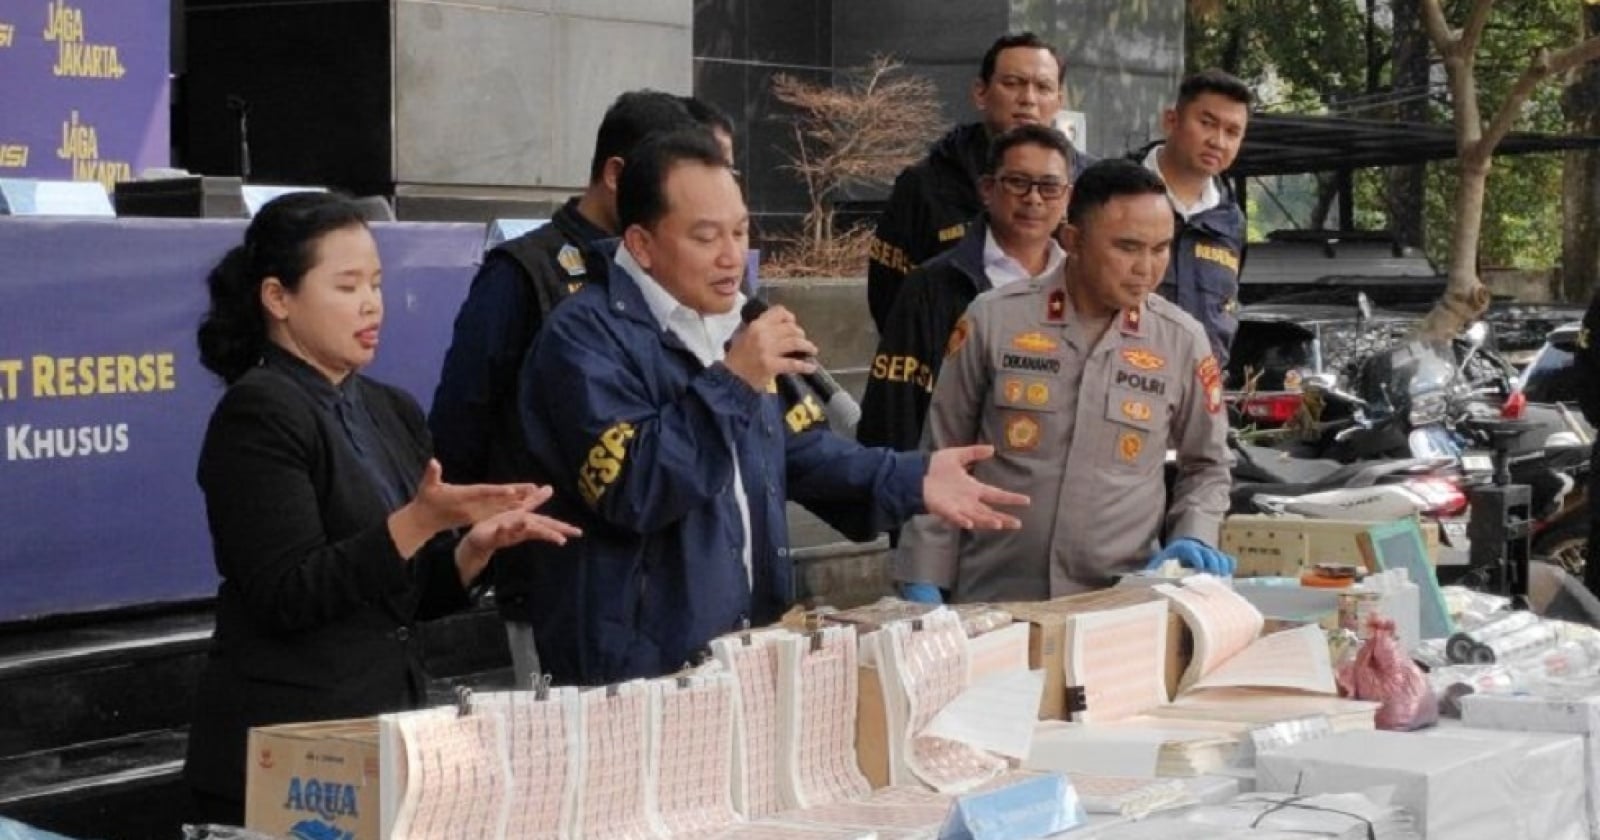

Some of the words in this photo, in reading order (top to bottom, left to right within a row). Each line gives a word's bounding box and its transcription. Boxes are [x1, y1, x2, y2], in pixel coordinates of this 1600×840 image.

[44, 1, 84, 41] JAGA
[53, 40, 120, 77] JAKARTA
[56, 113, 98, 159] JAGA
[32, 353, 175, 397] RESERSE
[1115, 369, 1165, 395] POLRI
[6, 423, 129, 460] KHUSUS
[283, 776, 358, 820] AQUA
